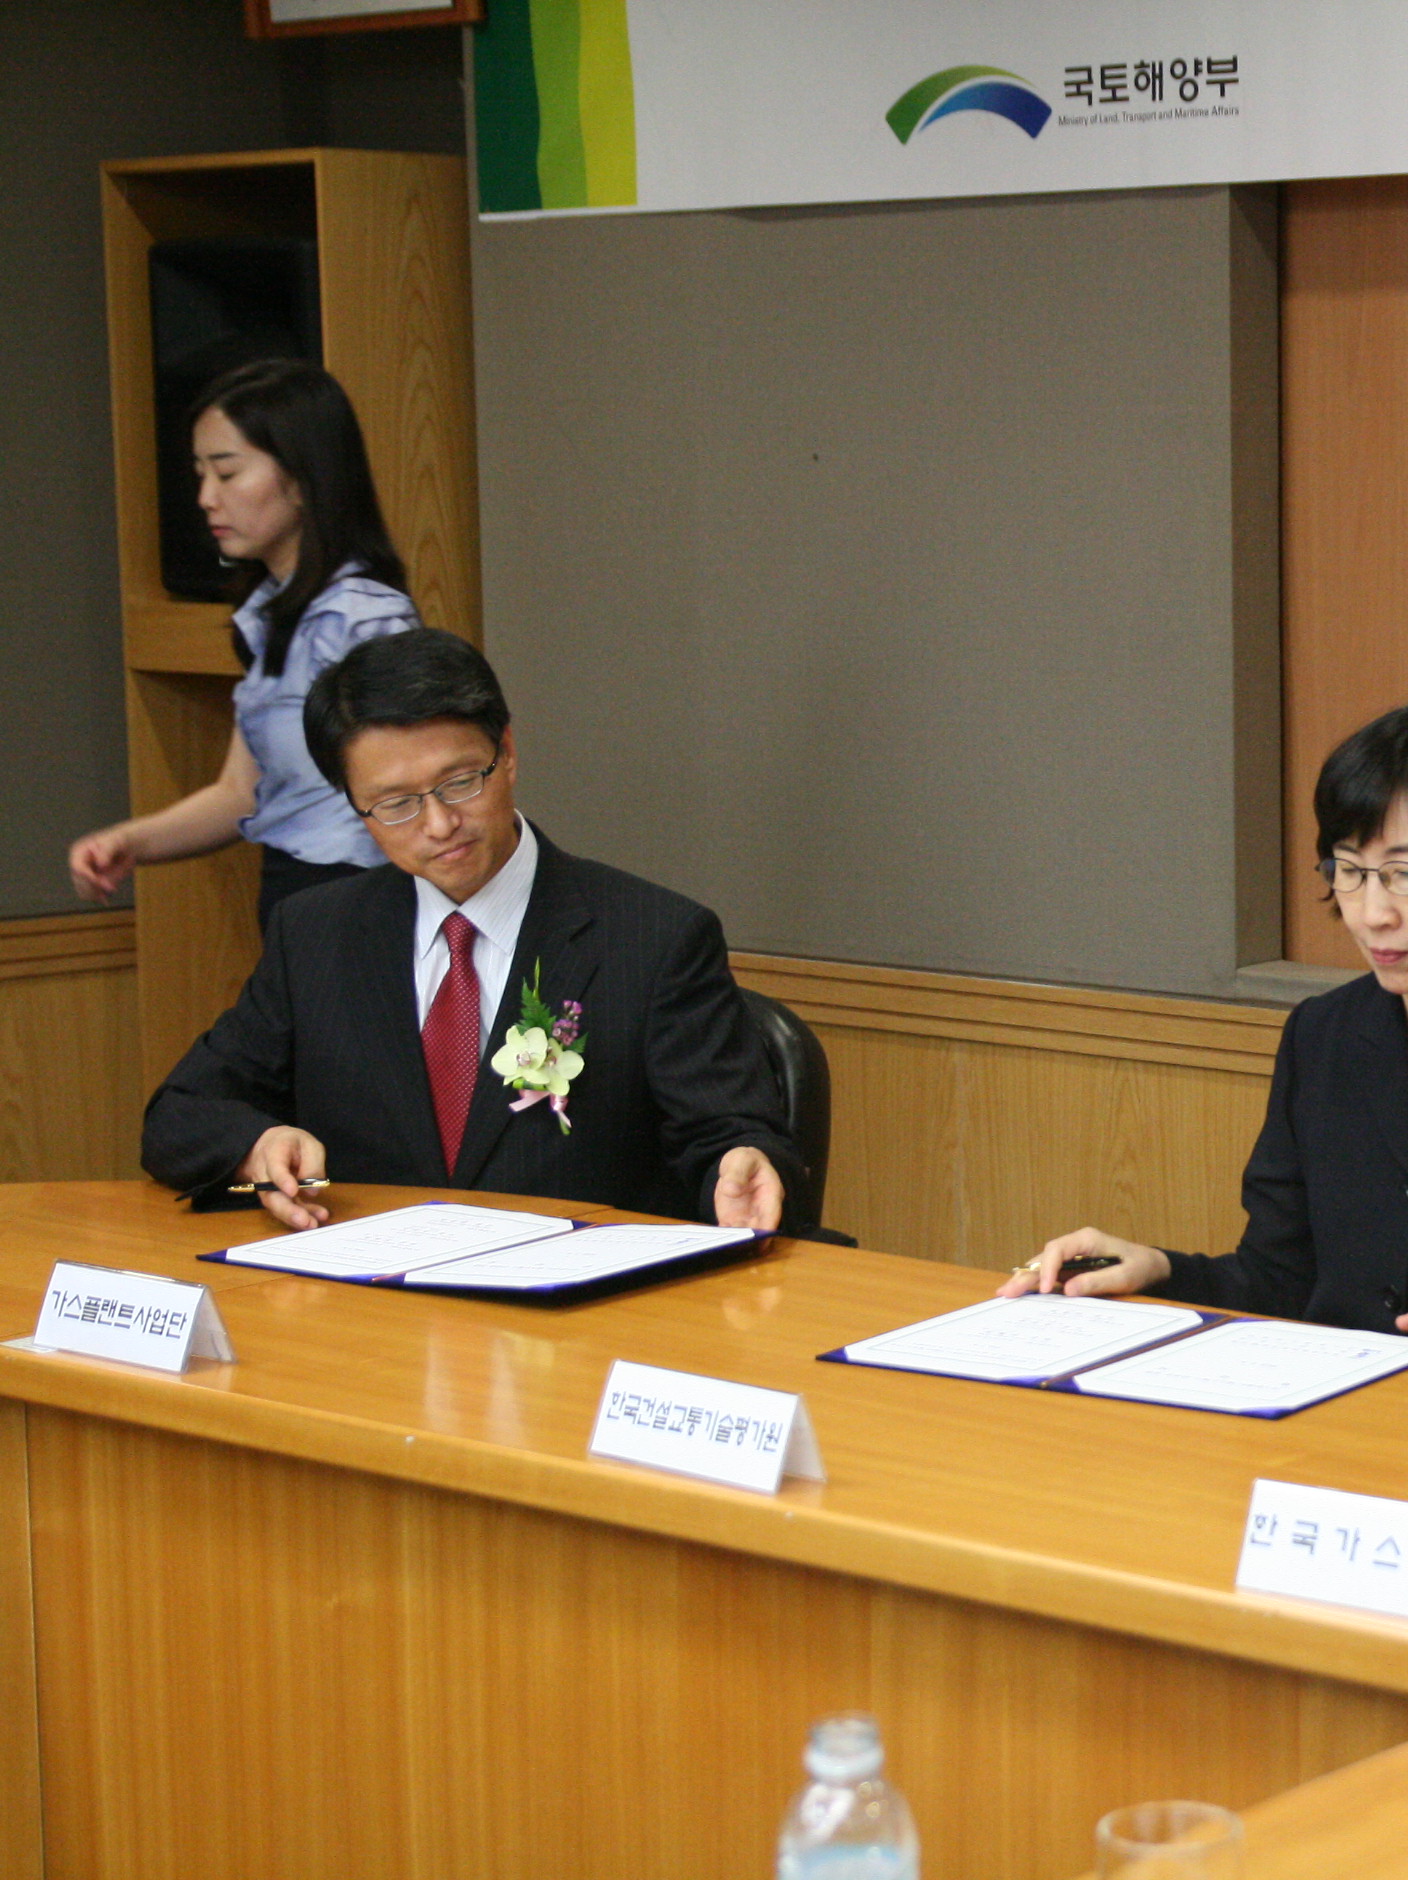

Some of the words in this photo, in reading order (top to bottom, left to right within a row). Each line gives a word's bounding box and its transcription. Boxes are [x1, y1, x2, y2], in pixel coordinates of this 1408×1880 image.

[1063, 54, 1240, 106] 국토해양부
[1058, 115, 1088, 127] Ministry
[1090, 114, 1098, 124] of
[1122, 110, 1157, 123] Transport
[1158, 109, 1172, 120] and
[1174, 106, 1209, 119] Maritime
[1211, 105, 1240, 117] Affairs
[52, 1289, 188, 1340] 가스플랜트사업단
[606, 1390, 783, 1453] 한국건설교통기술평가원
